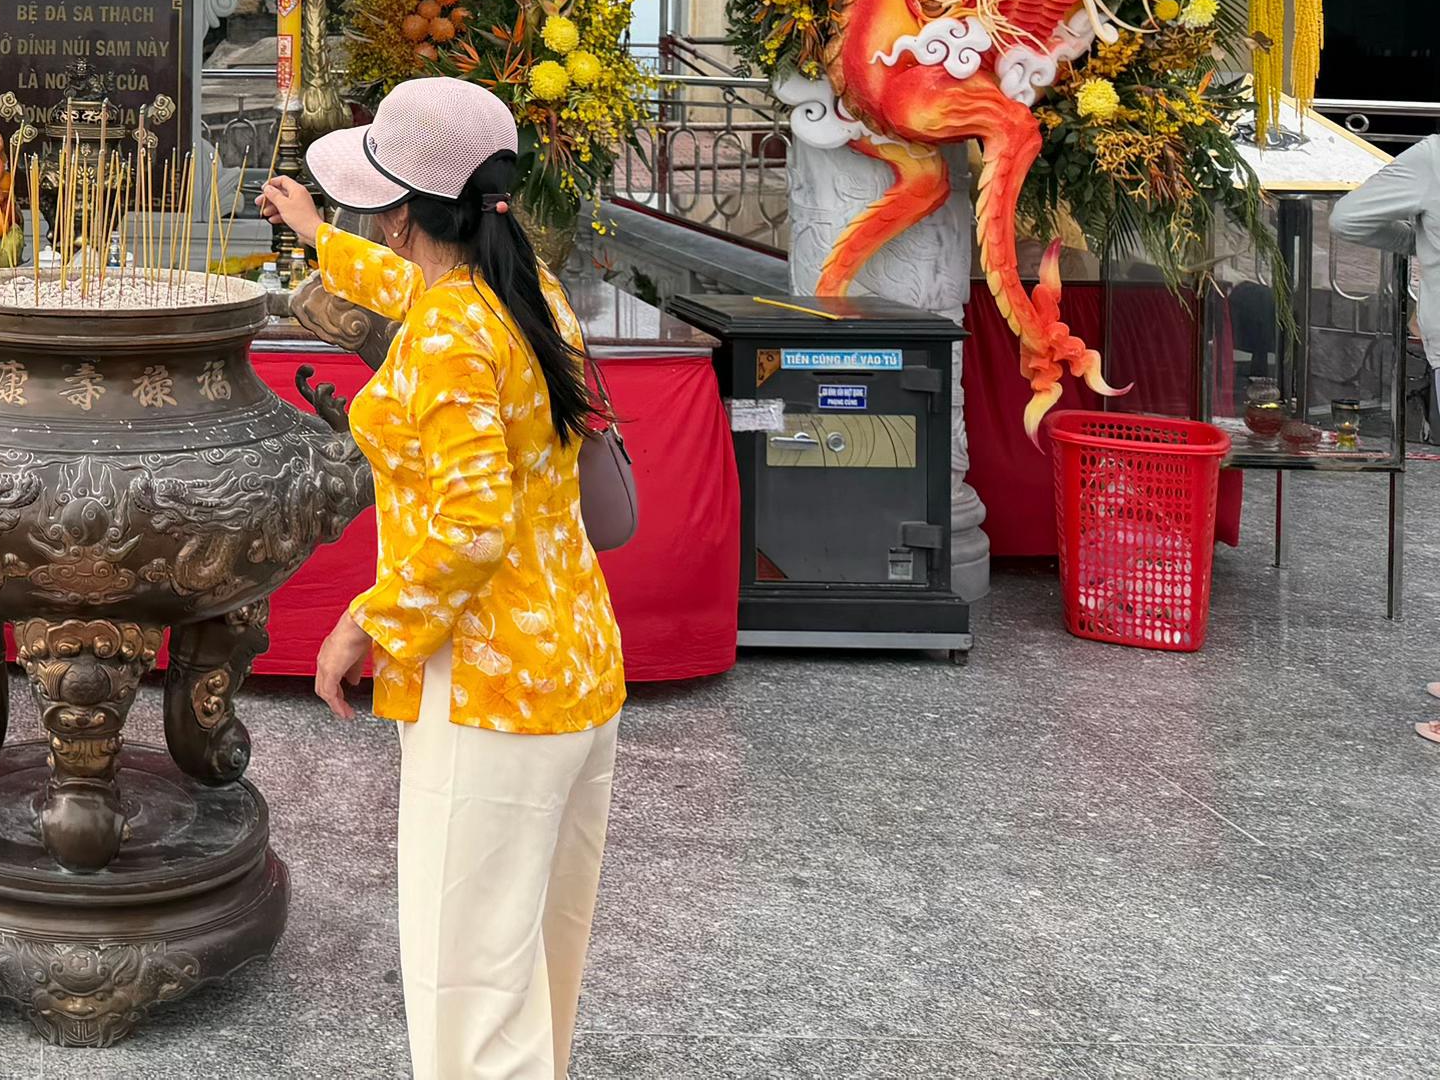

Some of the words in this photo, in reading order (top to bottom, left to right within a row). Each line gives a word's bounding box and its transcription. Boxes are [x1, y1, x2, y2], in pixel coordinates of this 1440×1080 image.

[16, 1, 38, 24] BỆ
[45, 1, 67, 21] ĐÁ
[73, 5, 94, 21] SA
[99, 5, 154, 26] THẠCH
[0, 32, 13, 55] Ở
[17, 33, 56, 55] ĐỈNH
[62, 35, 90, 56] NÚI
[96, 39, 131, 56] SAM
[136, 37, 170, 57] NÀY
[18, 68, 39, 89] LÀ
[116, 68, 150, 91] CỦA
[812, 354, 840, 365] CÚNG
[860, 354, 881, 365] VÀO
[883, 353, 897, 365] TỦ
